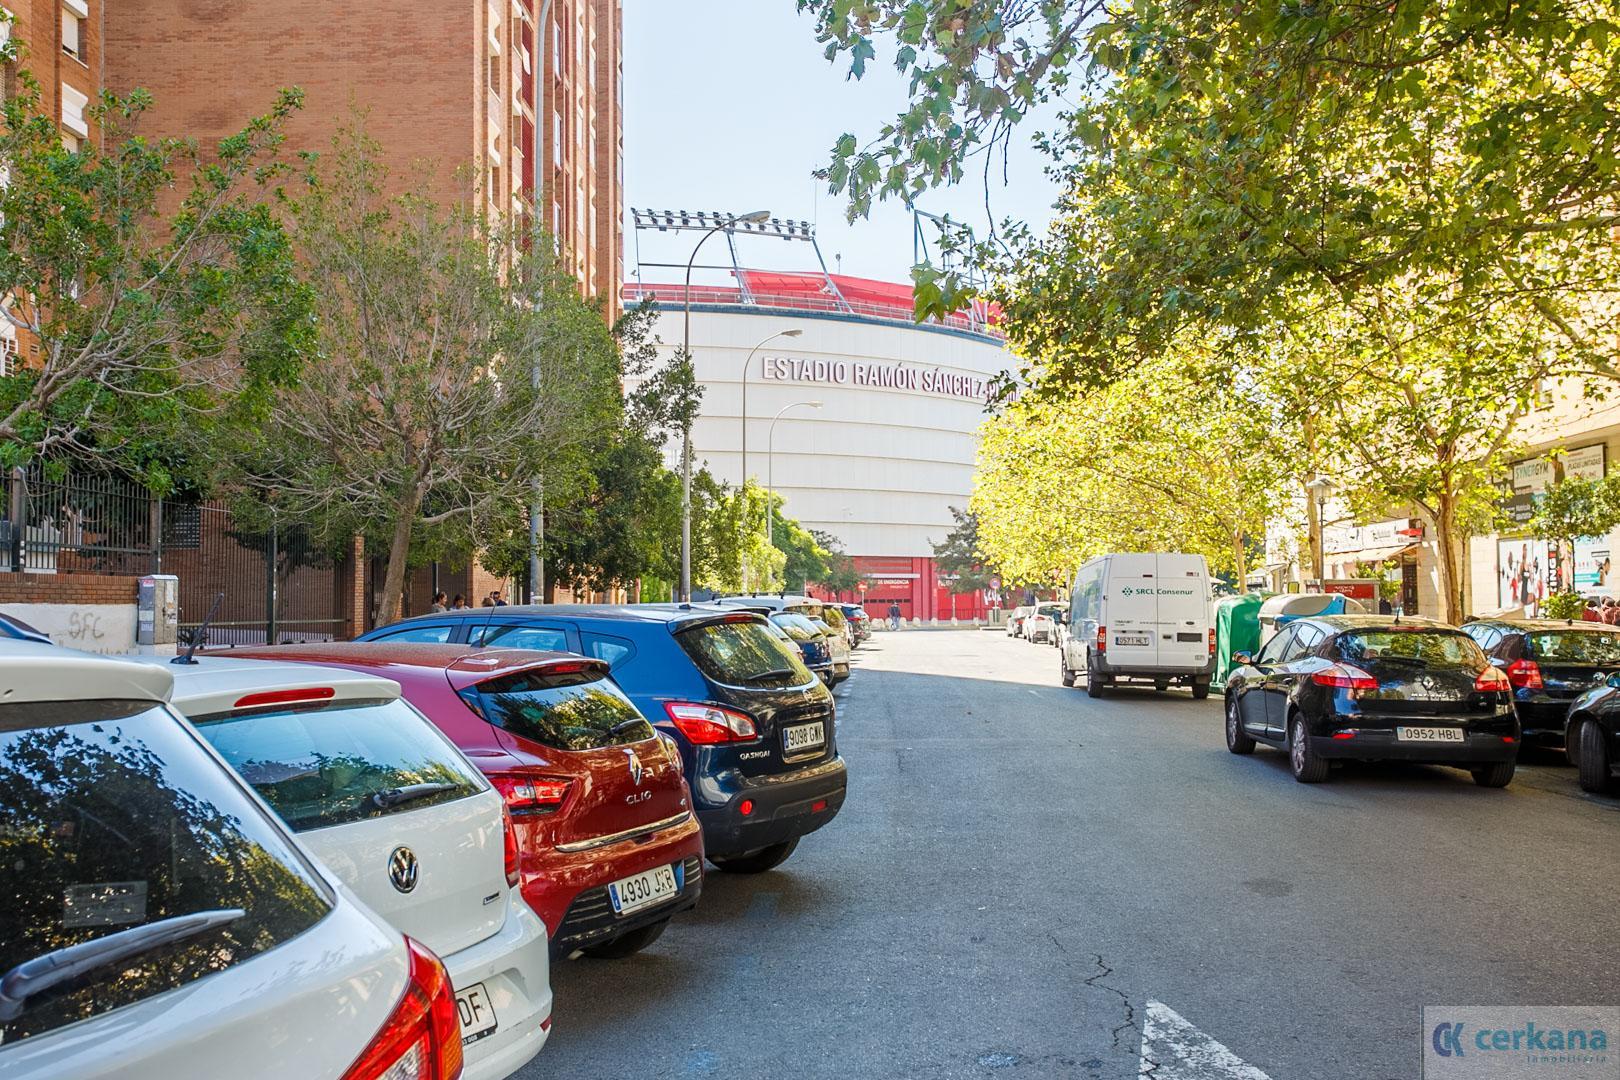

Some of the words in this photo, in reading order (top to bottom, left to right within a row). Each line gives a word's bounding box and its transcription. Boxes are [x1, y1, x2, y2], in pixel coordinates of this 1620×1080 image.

[762, 357, 848, 384] ESTADIO
[854, 362, 917, 390] RAMÓN
[1405, 728, 1435, 739] 0952
[1438, 729, 1461, 740] HBL
[626, 790, 652, 805] CLIO
[620, 876, 651, 904] 4930
